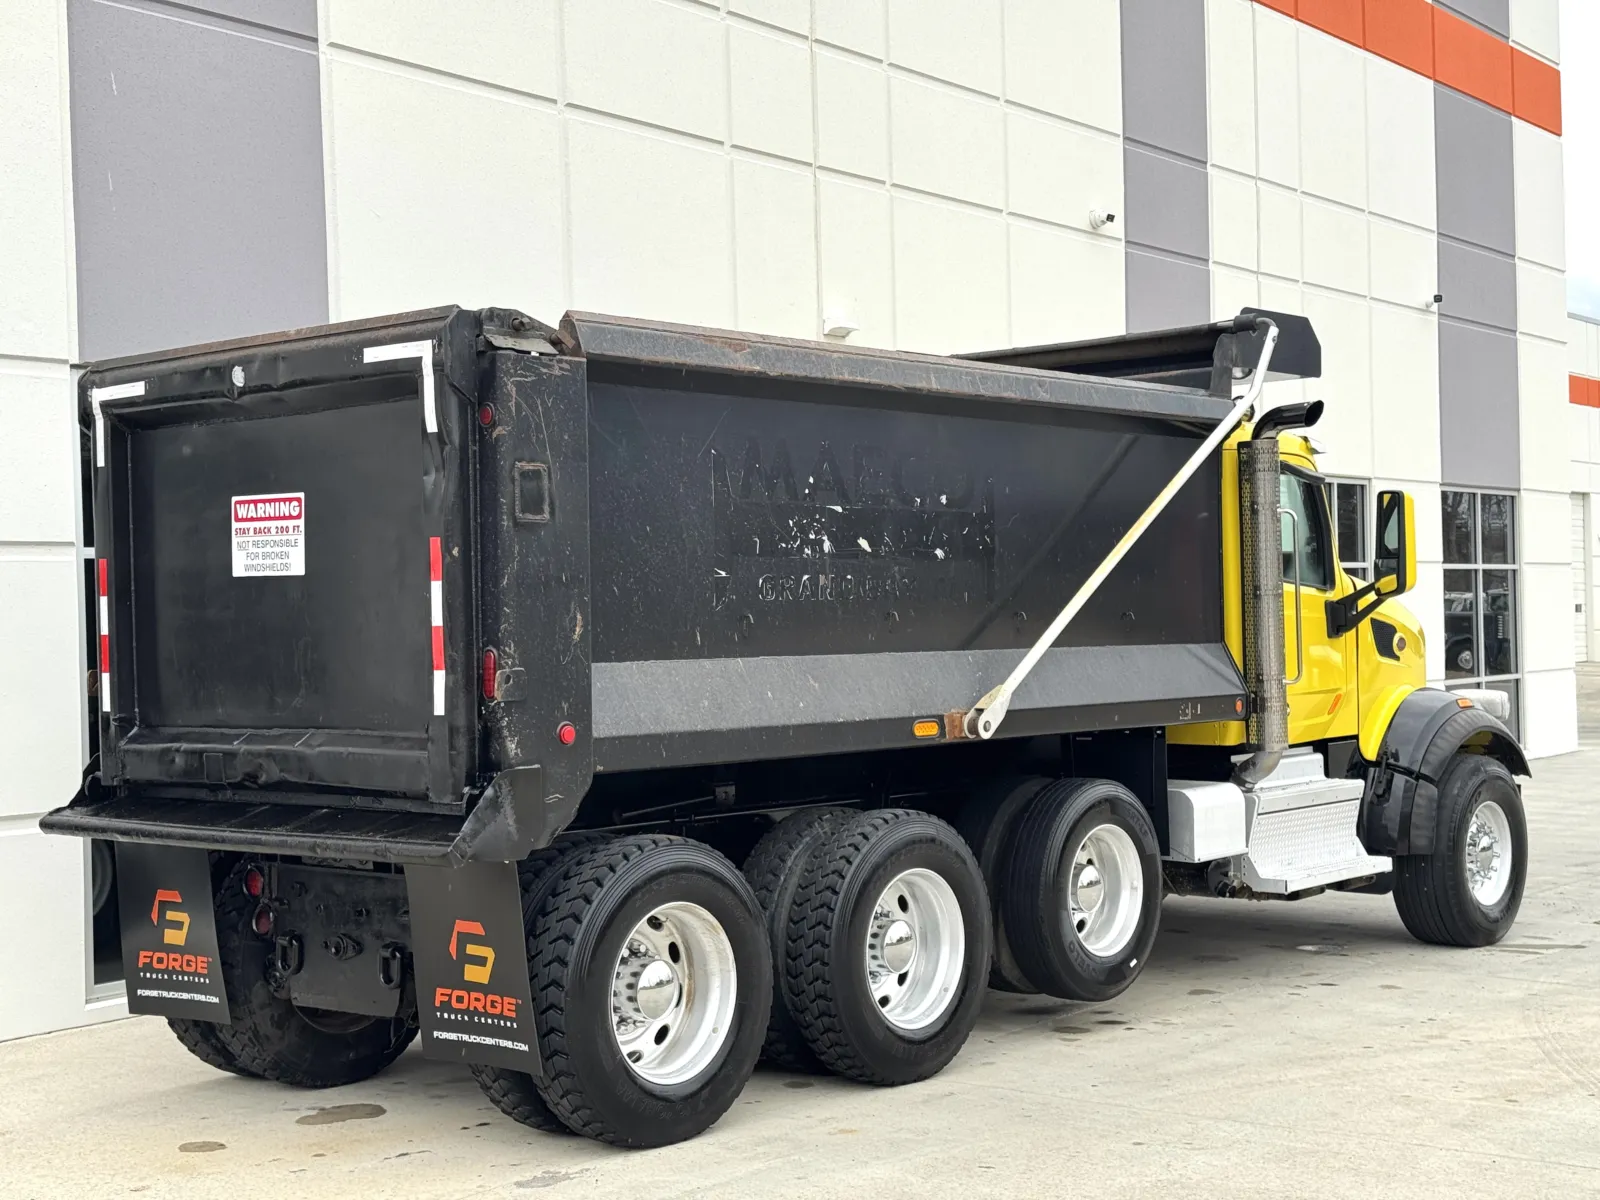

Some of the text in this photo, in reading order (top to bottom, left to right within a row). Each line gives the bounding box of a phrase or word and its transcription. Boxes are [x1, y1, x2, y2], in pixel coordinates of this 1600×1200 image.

[236, 500, 300, 519] WARNING
[234, 525, 303, 536] STAY BACK 200 FT.
[236, 539, 299, 549] NOT RESPONSIBLE
[246, 551, 290, 561] FOR BROKEN
[244, 563, 292, 572] WINDSHIELDS!
[138, 951, 208, 975] FORGE
[140, 972, 210, 984] TRUCK CENTERS
[137, 989, 220, 1004] FORGETRUCKCENTERS.COM
[434, 987, 517, 1018] FORGE
[436, 1012, 518, 1029] TRUCK CENTERS
[433, 1031, 529, 1051] FORGETRUCKCENTERS.COM
